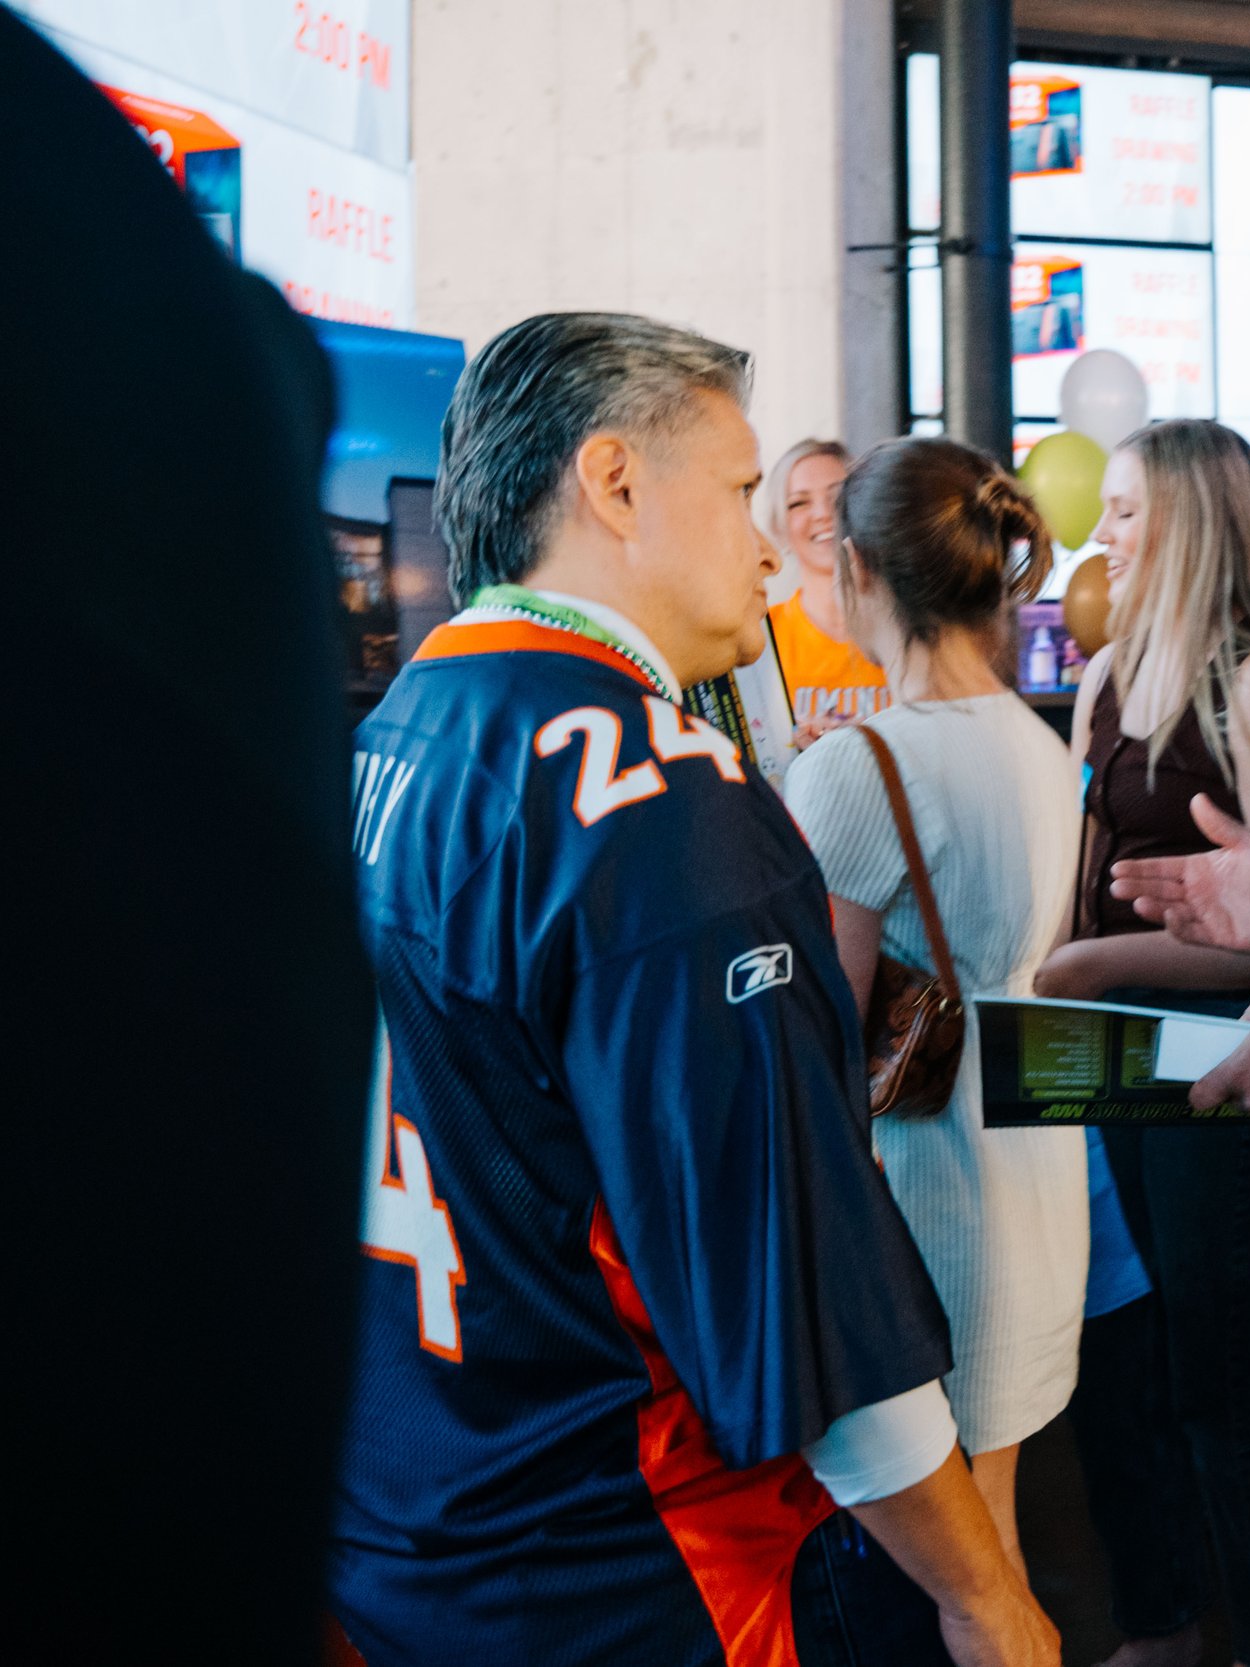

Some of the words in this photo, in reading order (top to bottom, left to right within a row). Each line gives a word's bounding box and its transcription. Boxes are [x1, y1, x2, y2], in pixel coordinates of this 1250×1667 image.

[358, 31, 392, 92] PM
[308, 187, 394, 263] RAFFLE
[533, 694, 747, 829] 24
